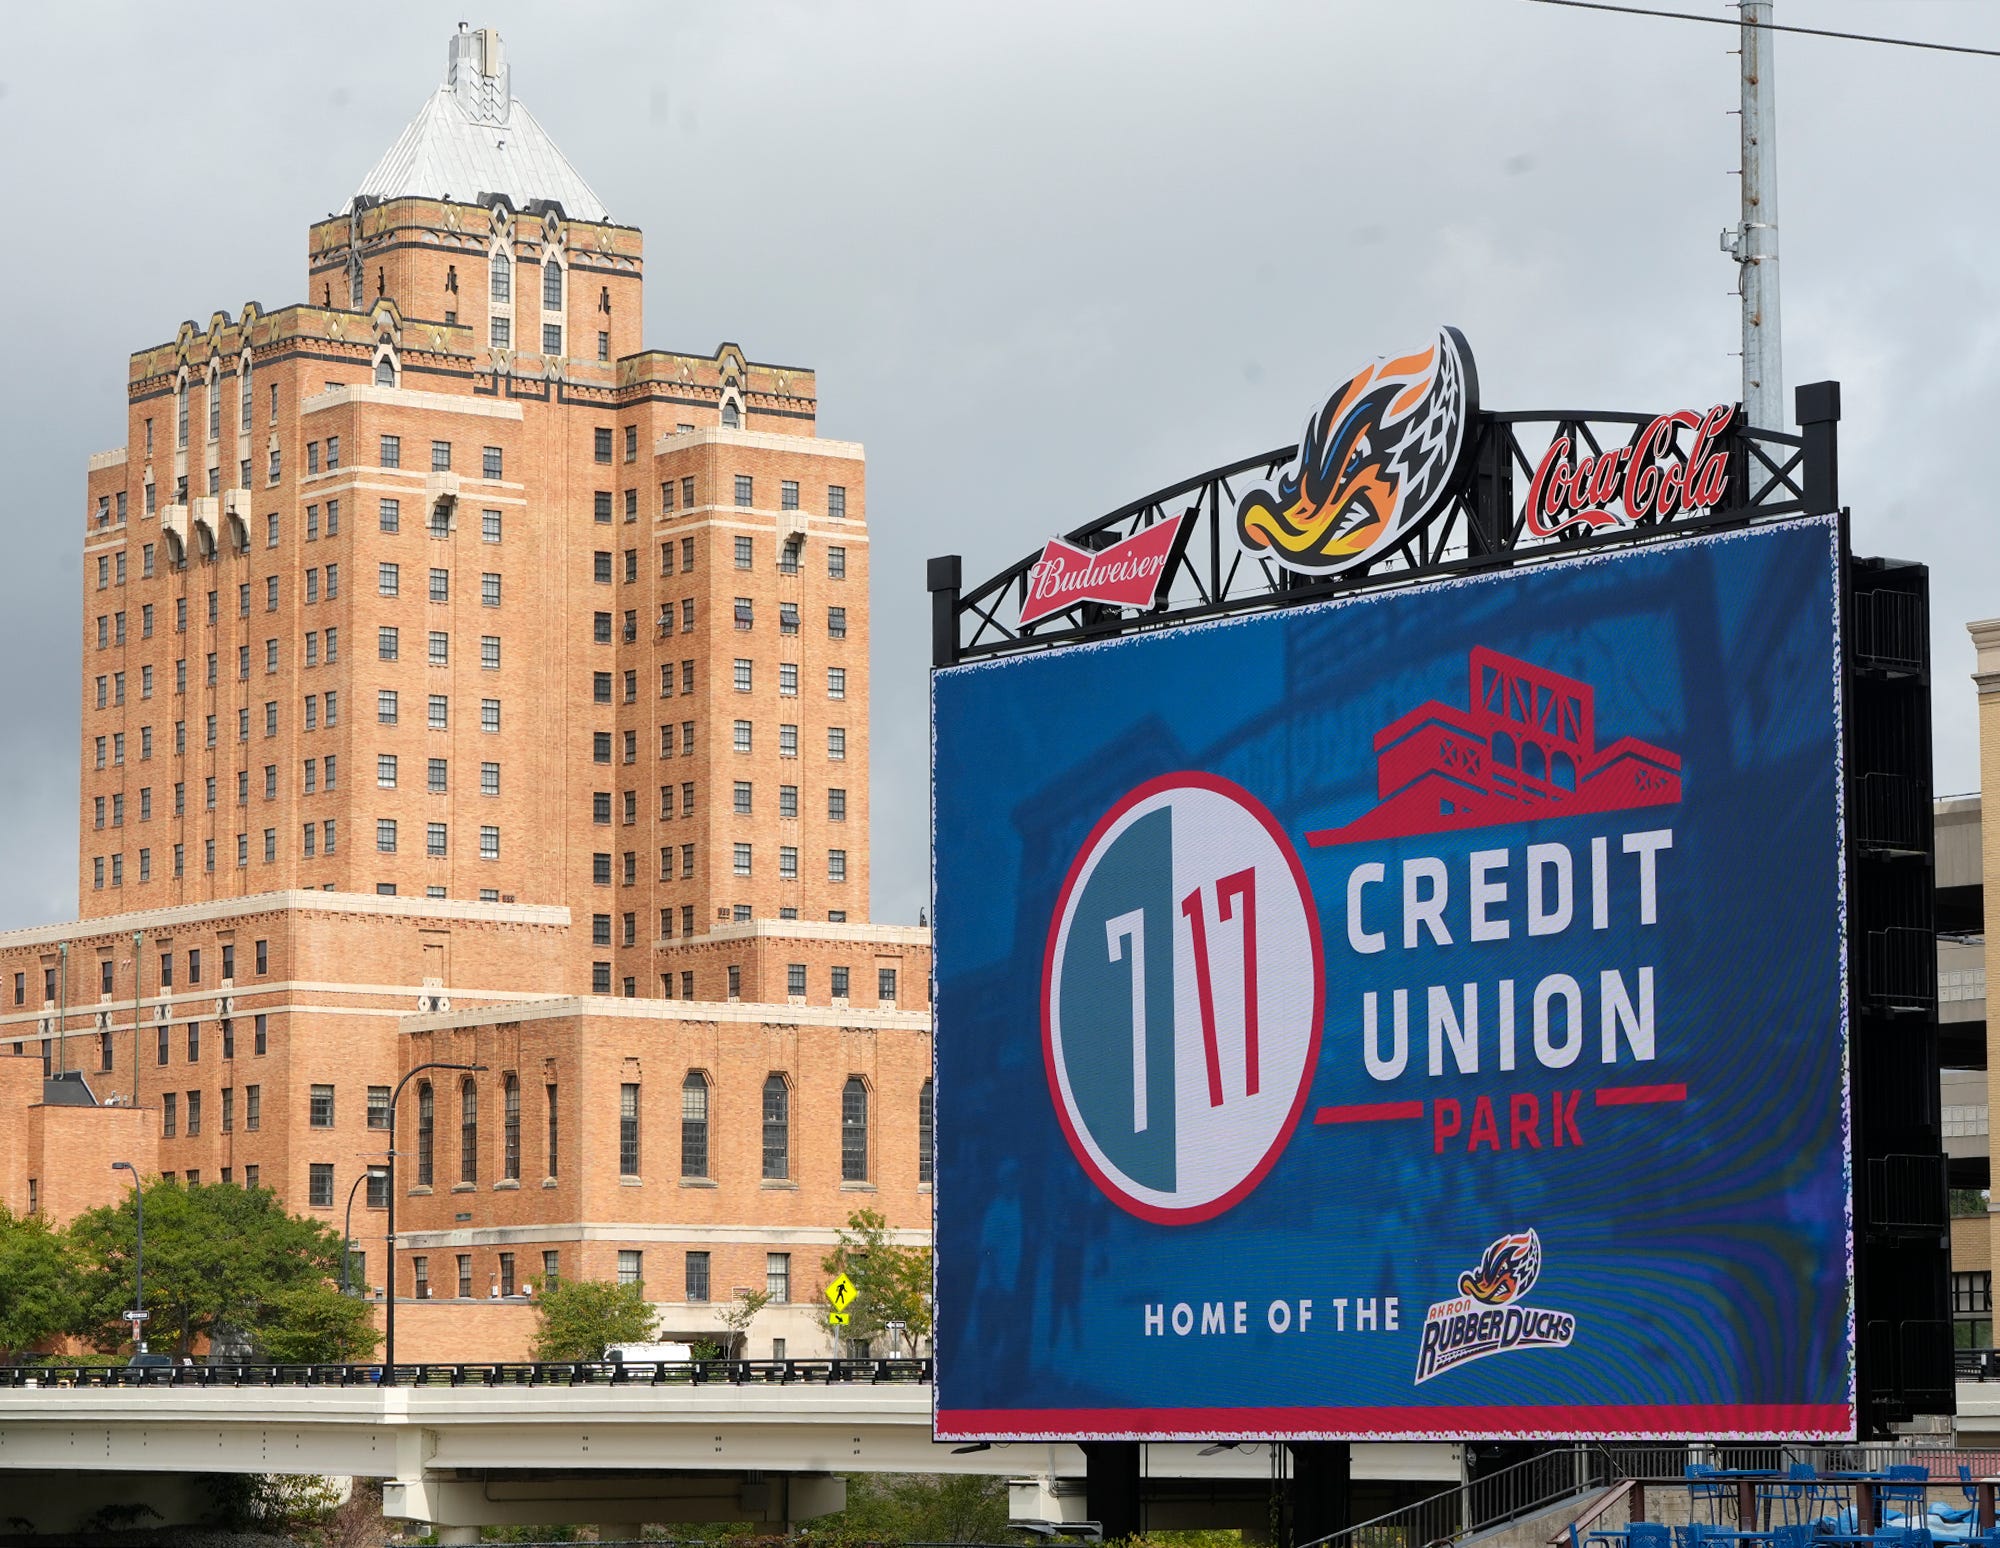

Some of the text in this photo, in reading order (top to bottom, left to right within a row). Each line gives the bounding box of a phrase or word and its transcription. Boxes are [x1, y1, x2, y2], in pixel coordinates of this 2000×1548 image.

[1525, 402, 1737, 537] Coca-Cola
[1031, 550, 1166, 600] Budweiser
[1346, 828, 1673, 955] CREDIT
[1363, 966, 1656, 1081] UNION
[1433, 1090, 1584, 1154] PARK
[1144, 1296, 1400, 1336] HOME OF THE
[1428, 1299, 1472, 1321] AKRON
